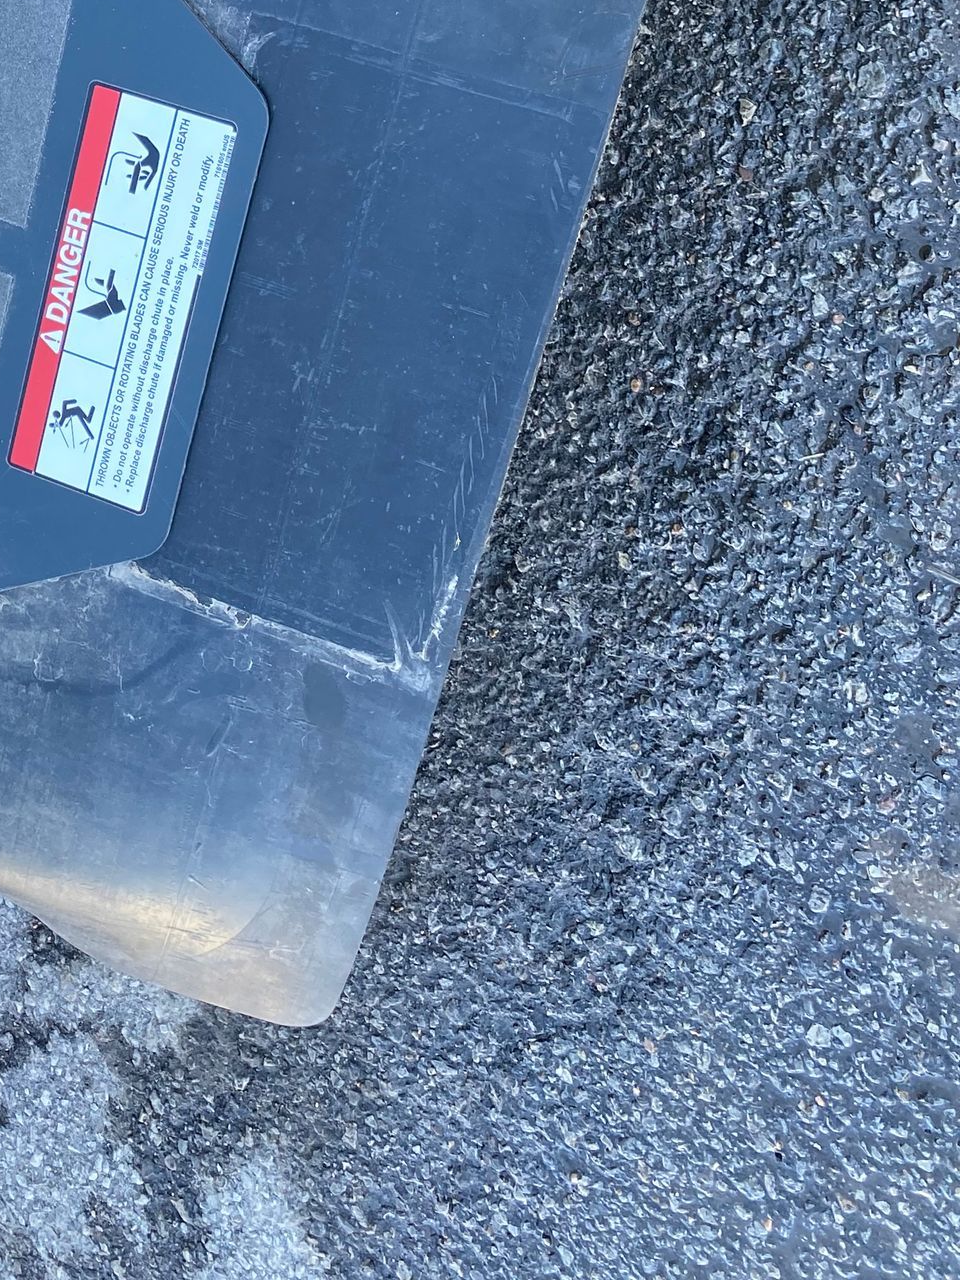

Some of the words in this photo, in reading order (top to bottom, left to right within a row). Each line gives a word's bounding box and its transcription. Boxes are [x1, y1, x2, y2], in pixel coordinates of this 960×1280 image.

[174, 117, 190, 151] DEATH
[170, 150, 182, 168] OR
[195, 152, 215, 192] modify.
[162, 167, 178, 203] INJURY
[193, 190, 204, 204] or
[151, 203, 170, 247] SERIOUS
[186, 203, 201, 230] weld
[179, 228, 195, 260] Never
[45, 205, 91, 325] DANGER
[143, 245, 160, 280] CAUSE
[159, 254, 176, 285] place.
[138, 279, 152, 302] CAN
[156, 285, 167, 297] in
[168, 259, 189, 304] missing.
[129, 301, 146, 341] BLADES
[149, 296, 164, 326] chute
[166, 303, 177, 316] or
[137, 325, 159, 376] discharge
[154, 315, 175, 363] damaged
[118, 340, 137, 389] ROTATING
[152, 362, 162, 371] if
[114, 387, 126, 404] OR
[129, 374, 146, 413] without
[145, 371, 160, 400] chute
[104, 402, 122, 447] OBJECTS
[120, 412, 138, 451] operate
[134, 399, 155, 449] discharge
[94, 446, 112, 488] THROWN
[111, 467, 123, 483] Do
[116, 449, 128, 468] not
[124, 447, 143, 488] Replace
